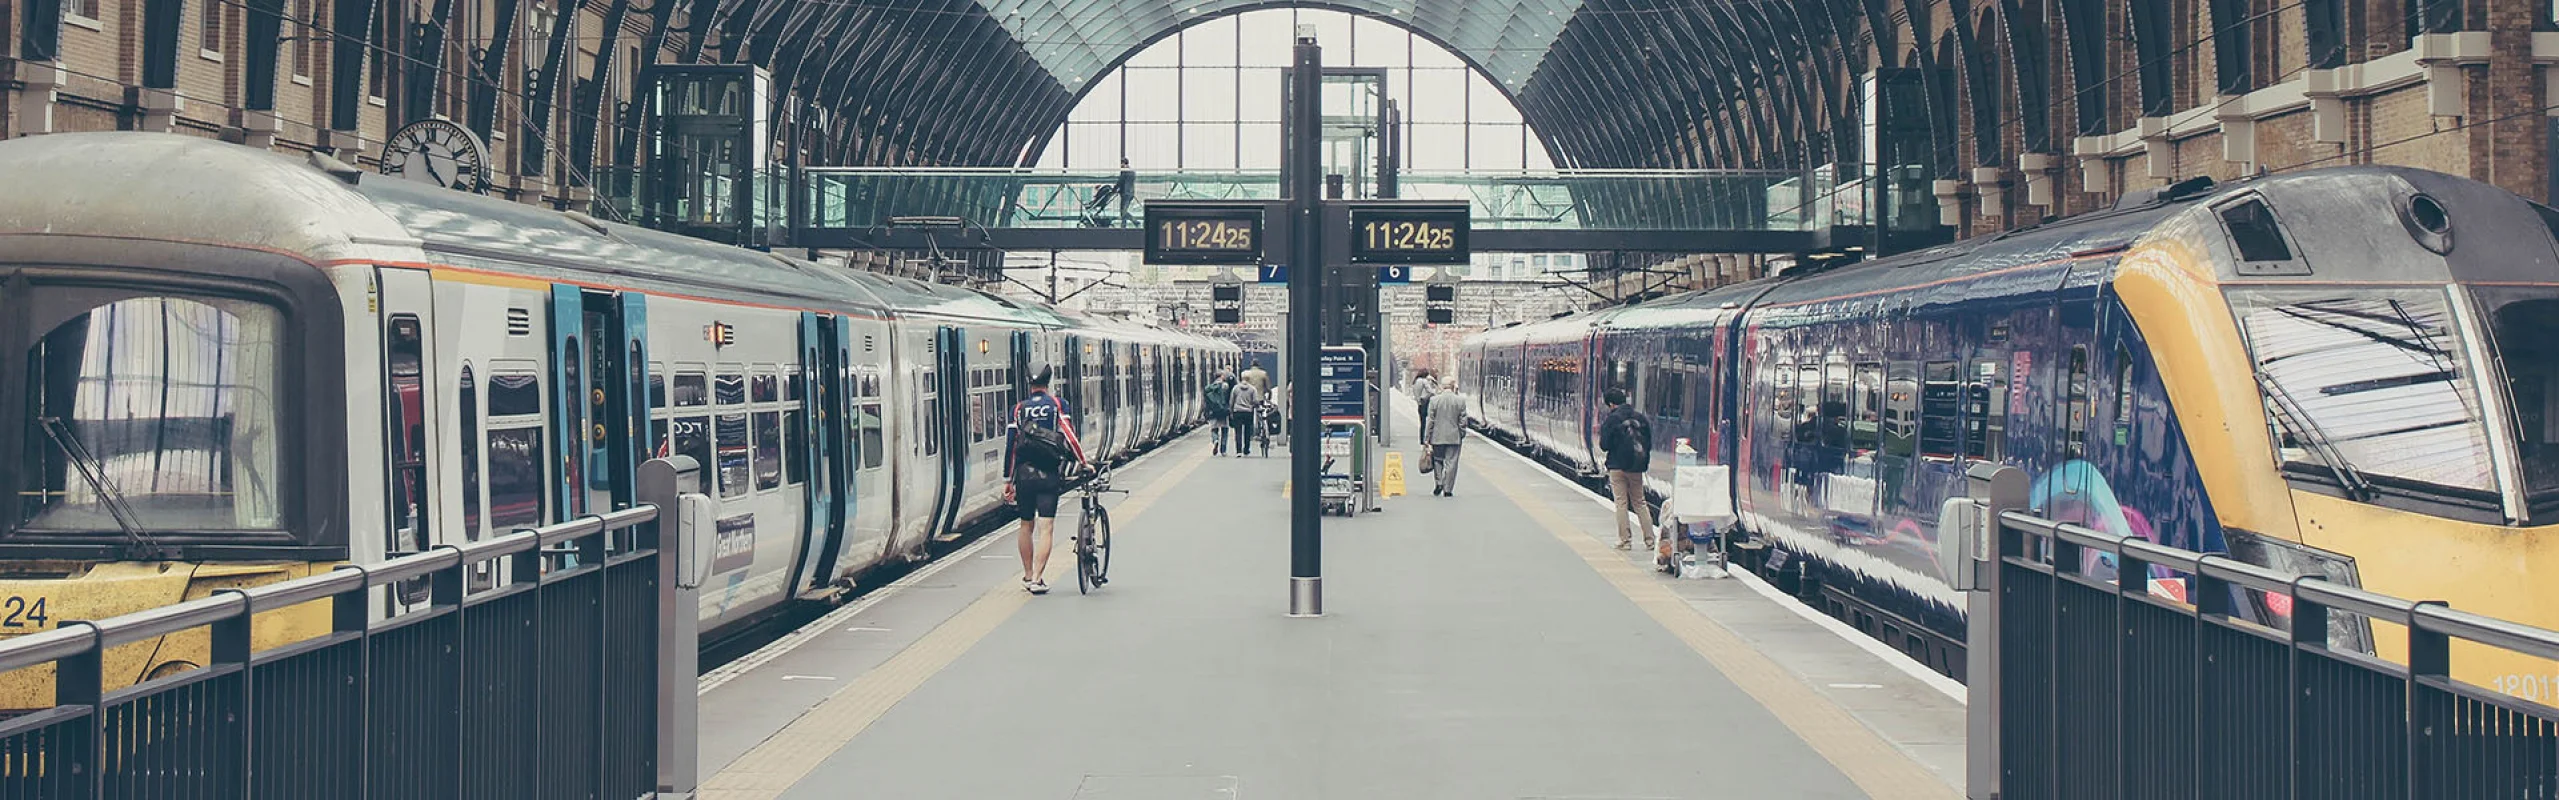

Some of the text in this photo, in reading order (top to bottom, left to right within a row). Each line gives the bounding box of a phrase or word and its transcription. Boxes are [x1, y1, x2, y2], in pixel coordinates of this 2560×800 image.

[1267, 264, 1278, 278] 7
[1389, 265, 1400, 278] 6
[1024, 405, 1050, 418] TCC
